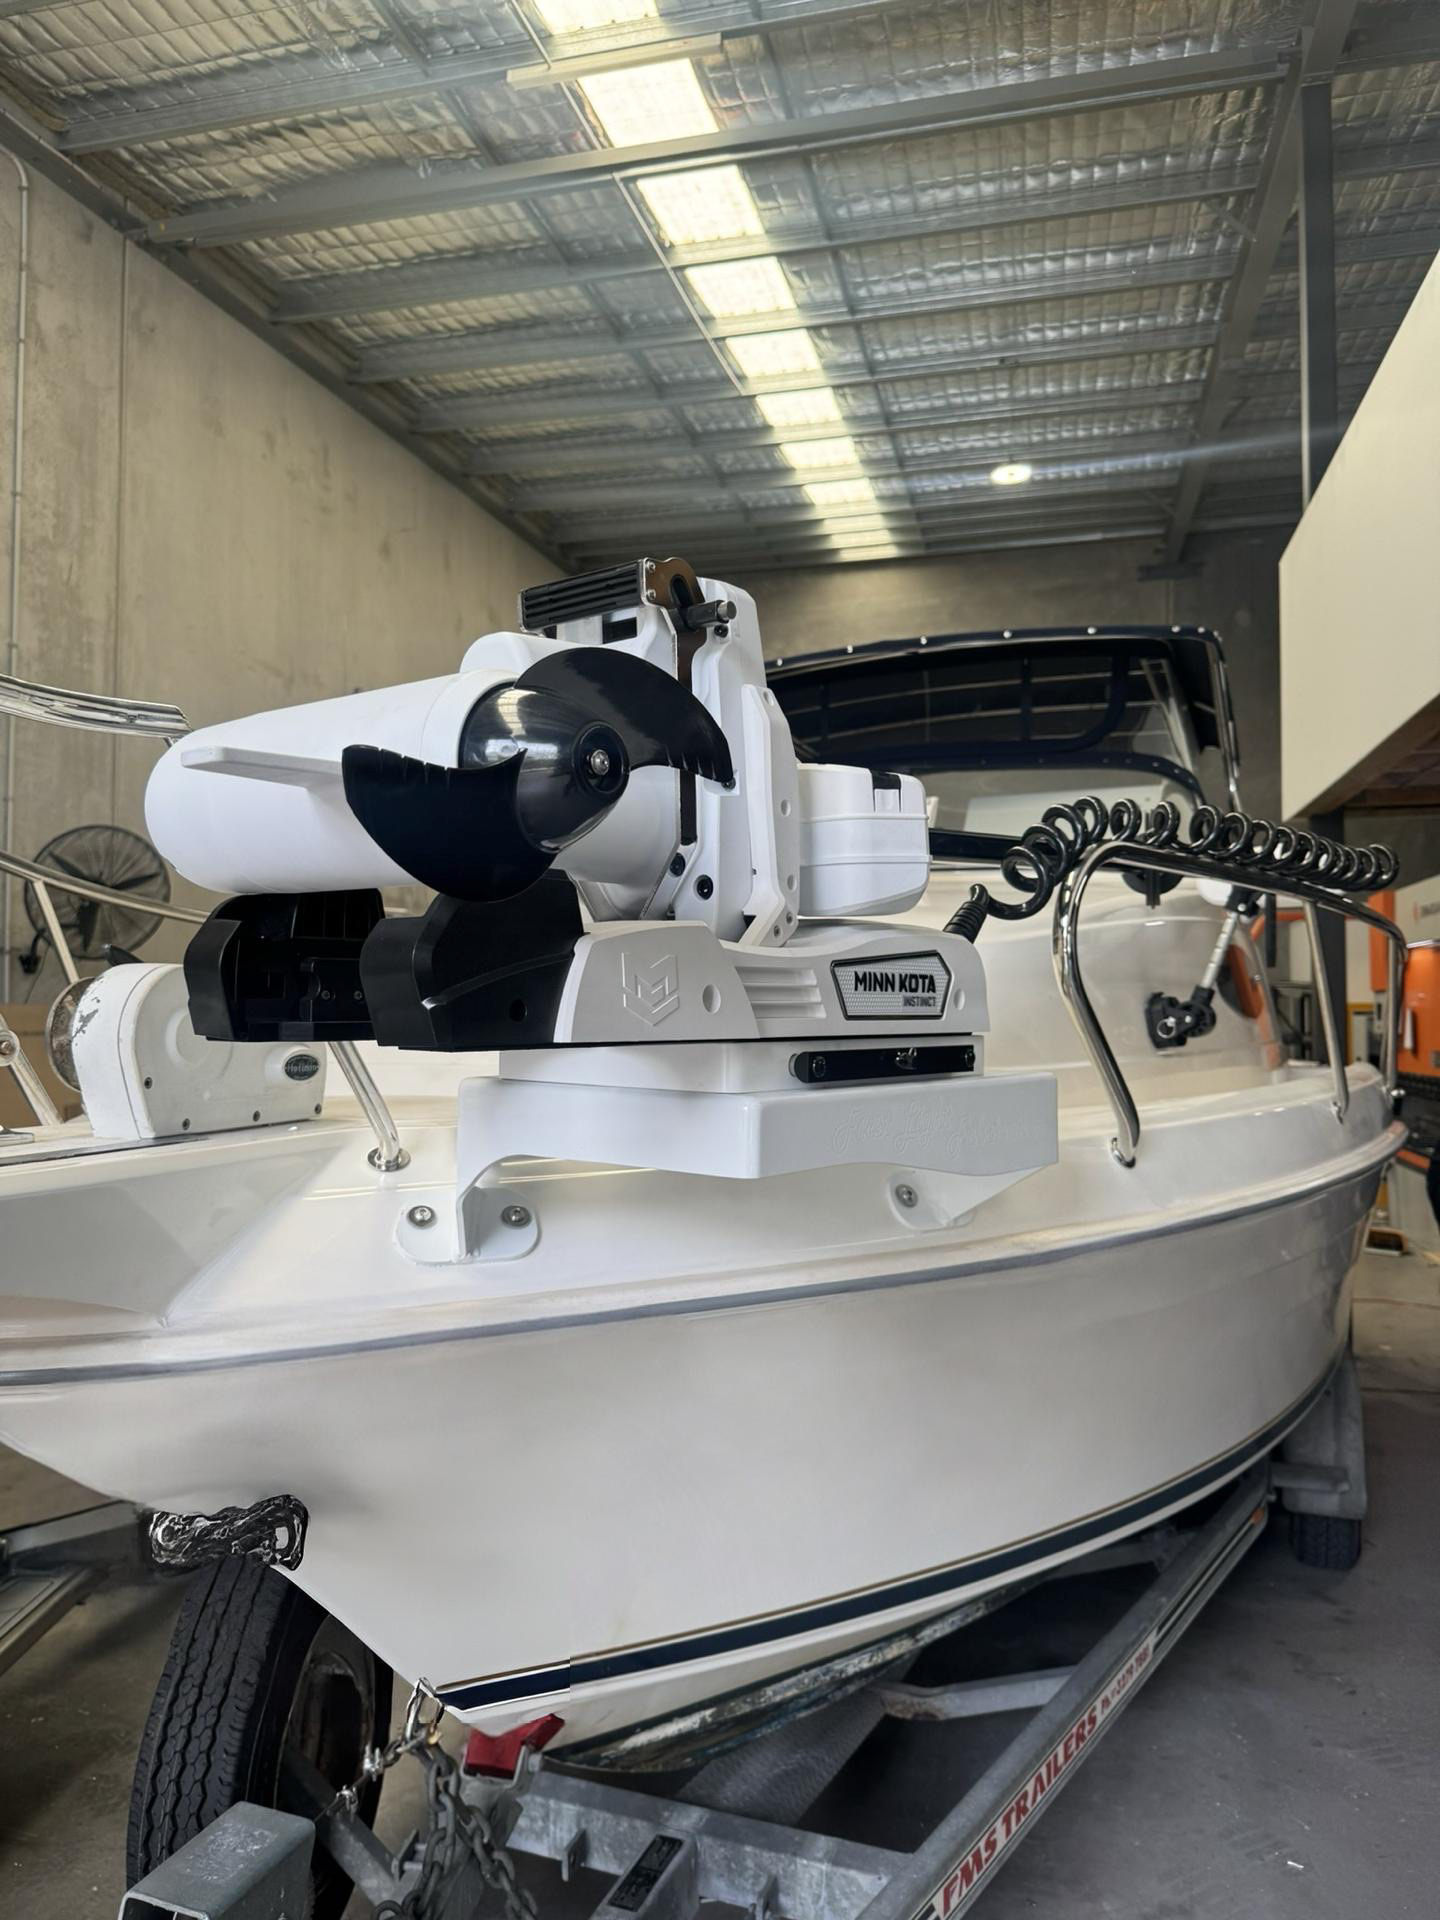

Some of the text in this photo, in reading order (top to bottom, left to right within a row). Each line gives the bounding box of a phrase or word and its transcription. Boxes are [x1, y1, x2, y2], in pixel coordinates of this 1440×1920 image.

[854, 971, 936, 993] MINN KOTA
[903, 996, 937, 1007] INSTINCT
[943, 1829, 998, 1916] FMS
[1002, 1705, 1098, 1839] TRAILERS
